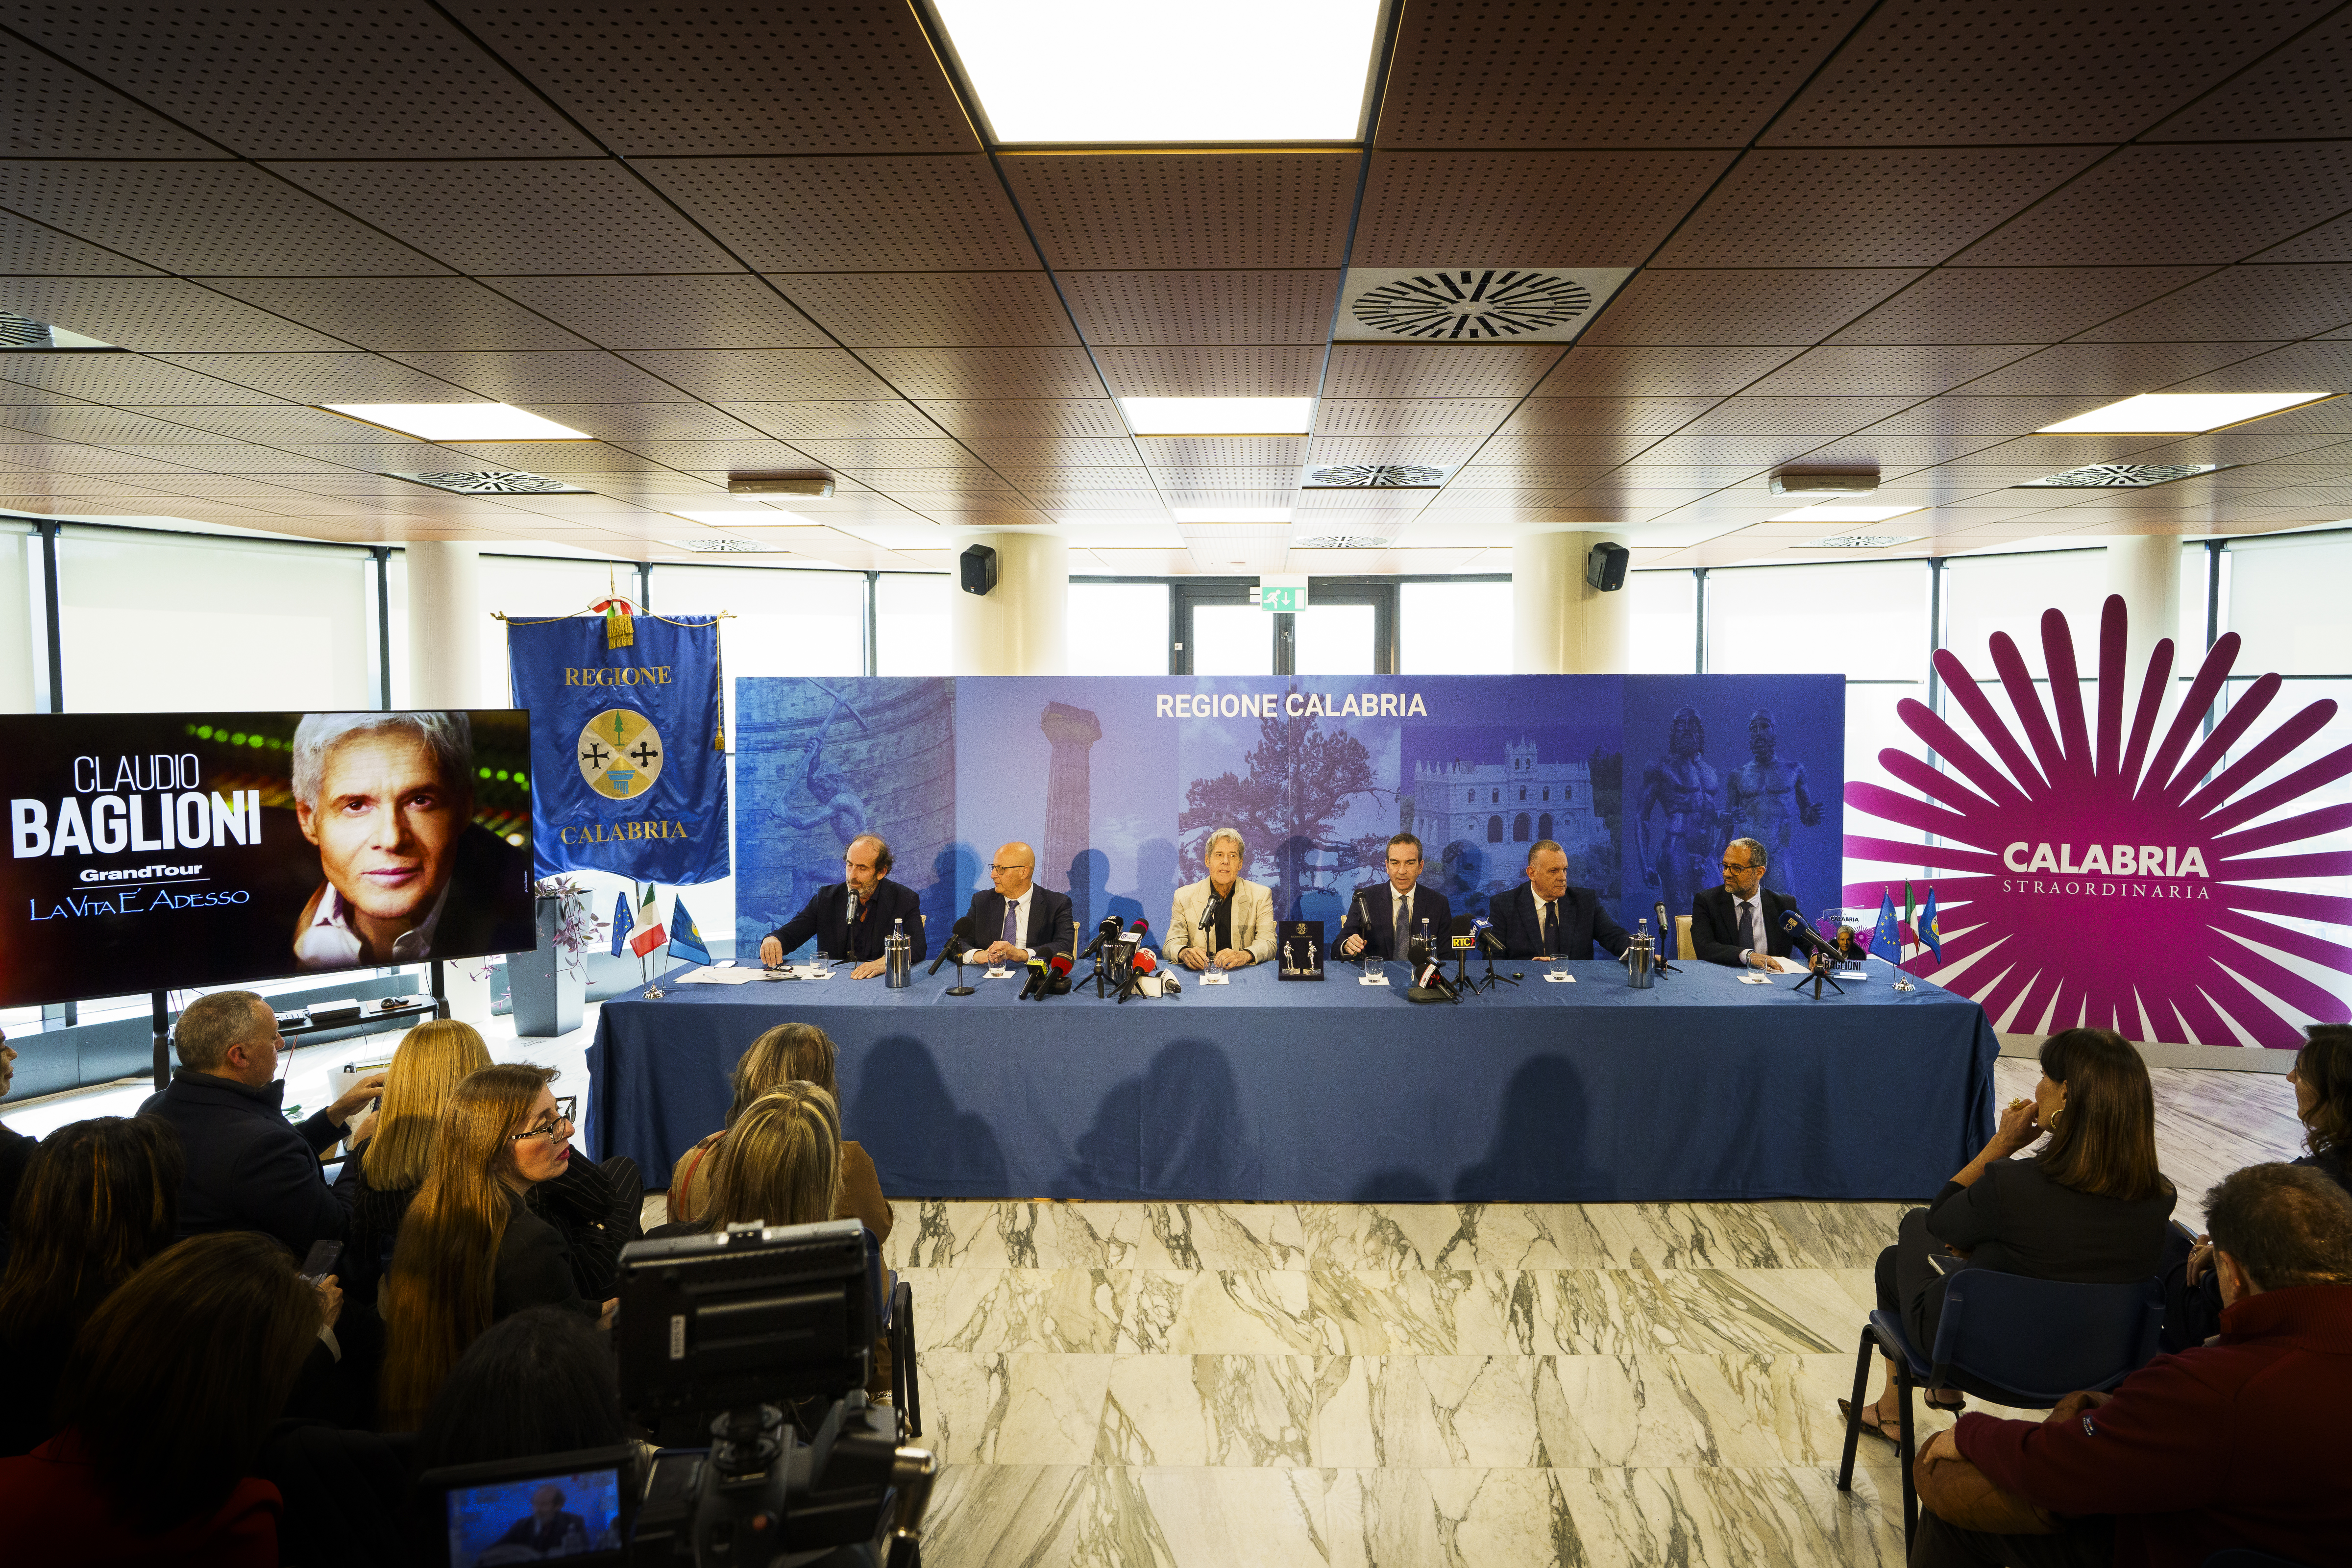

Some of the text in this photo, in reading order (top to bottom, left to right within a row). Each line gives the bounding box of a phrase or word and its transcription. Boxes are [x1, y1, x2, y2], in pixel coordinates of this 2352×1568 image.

[564, 666, 672, 686] REGIONE
[1157, 693, 1427, 717] REGIONE CALABRIA
[74, 753, 199, 793] CLAUDIO
[11, 789, 262, 858] BAGLIONI
[561, 820, 687, 844] CALABRIA
[2003, 841, 2209, 878] CALABRIA
[79, 864, 202, 882] GrandTour
[2003, 880, 2210, 899] STRAORDINARIA
[1784, 918, 1797, 933] TGR
[1825, 960, 1861, 971] BAGLIONI
